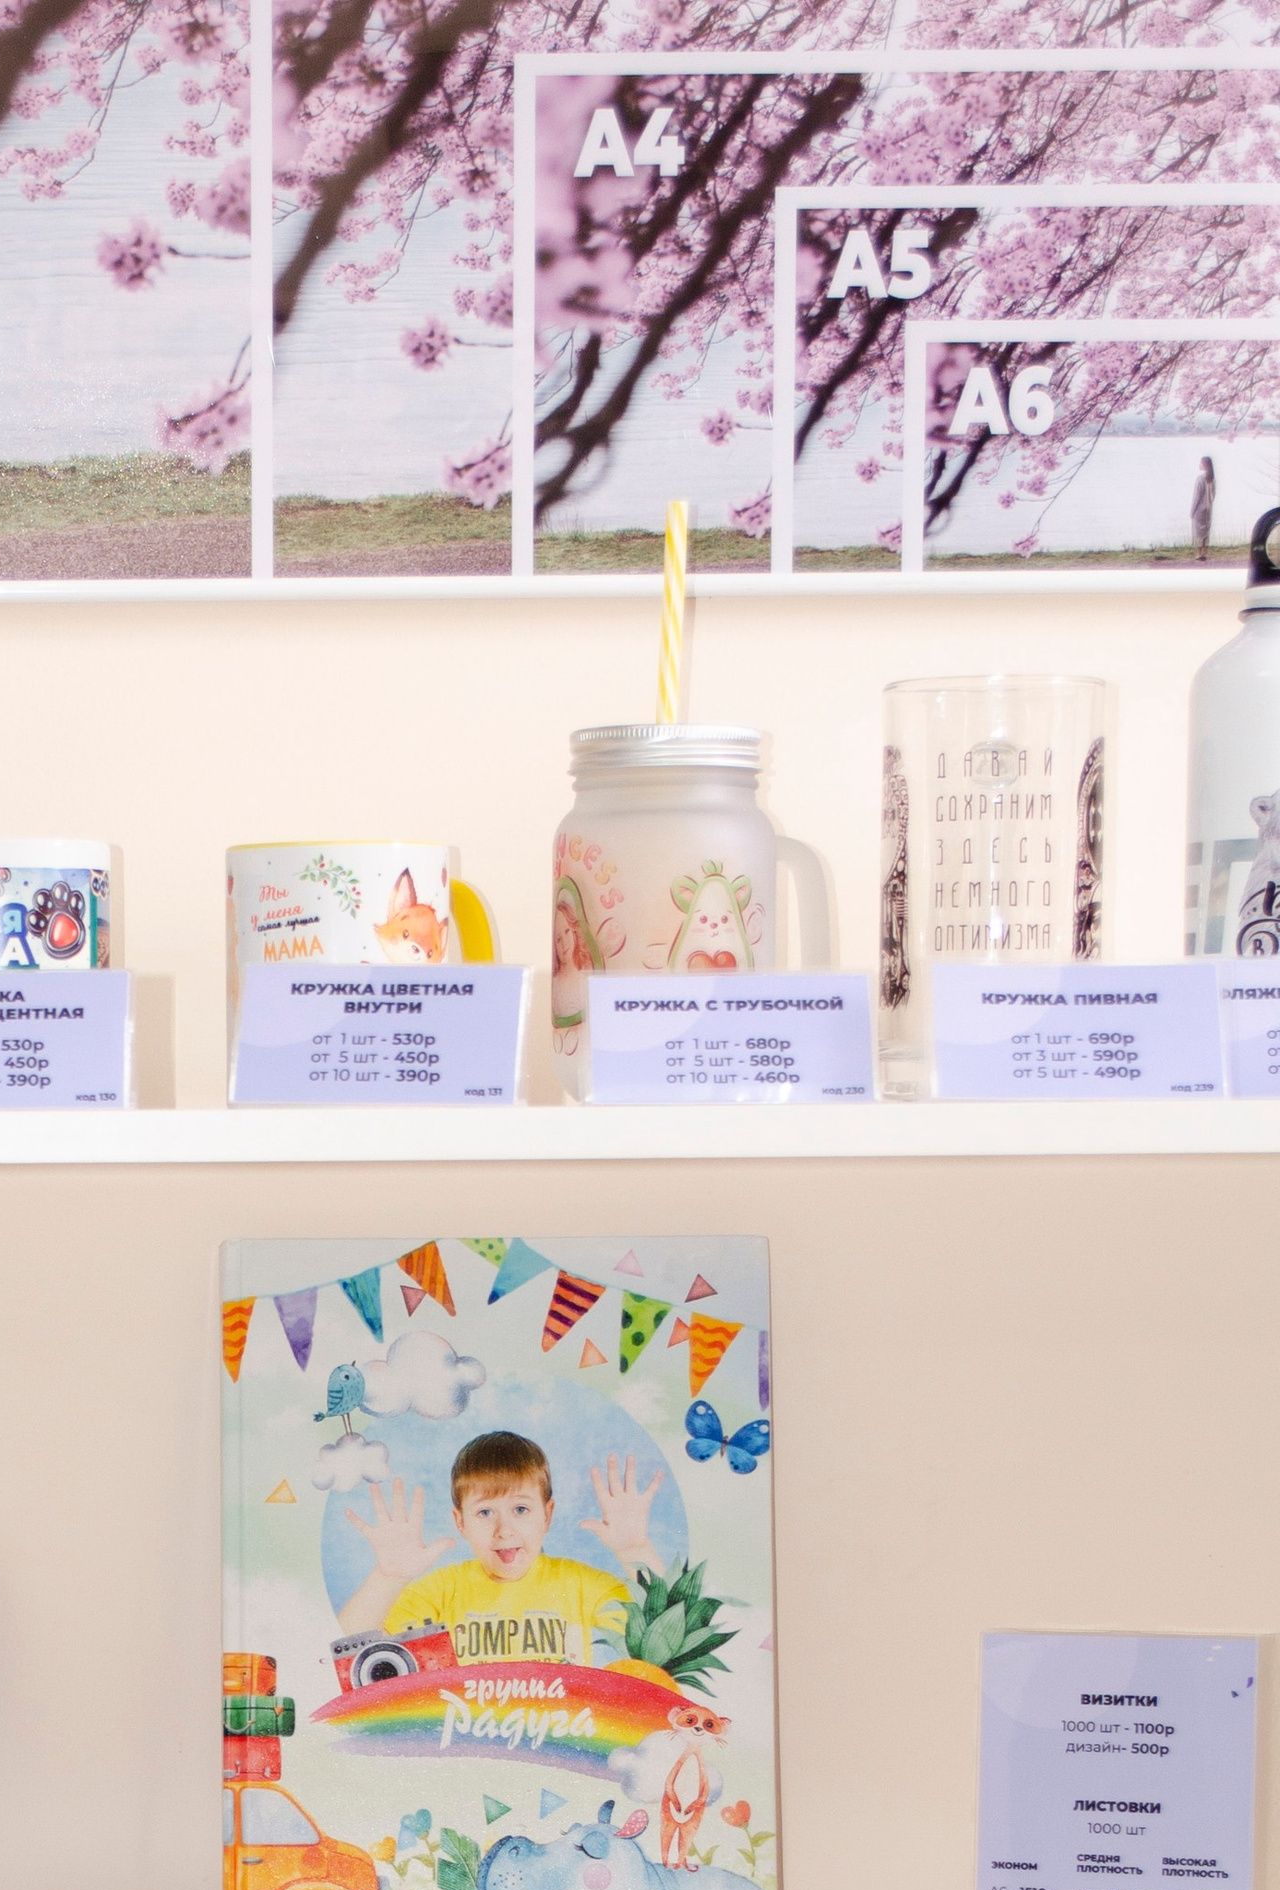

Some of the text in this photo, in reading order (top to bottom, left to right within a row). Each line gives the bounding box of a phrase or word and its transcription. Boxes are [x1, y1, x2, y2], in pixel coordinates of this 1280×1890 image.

[574, 108, 685, 178] A4
[827, 230, 933, 299] A5
[948, 367, 1055, 437] A6
[937, 748, 1053, 780] ДАВАЙ
[937, 793, 1052, 823] СОХРАНИМ
[936, 837, 1052, 866] ЗДЕСЬ
[935, 880, 1051, 908] НЕМНОГО
[934, 923, 1051, 952] ОПТИМИЗМА
[263, 934, 325, 963] МАМА
[291, 983, 474, 998] КРУЖКА ЦВЕТНАЯ
[614, 996, 843, 1012] КРУЖКА С ТРУБОЧКОЙ
[981, 992, 1159, 1006] КРУЖКА ПИВНАЯ
[344, 1002, 422, 1014] ВНУТРИ
[0, 1039, 45, 1054] 530р
[392, 1033, 436, 1046] 530р
[745, 1038, 791, 1051] 680р
[1088, 1032, 1135, 1047] 690р
[4, 1056, 50, 1071] 450р
[394, 1051, 440, 1065] 450р
[749, 1055, 795, 1068] 580р
[1092, 1049, 1139, 1064] 590р
[395, 1069, 441, 1083] 390р
[1094, 1066, 1142, 1081] 490р
[6, 1074, 51, 1089] 390р
[1170, 1084, 1215, 1093] код 239
[75, 1093, 117, 1103] код 130
[822, 1087, 865, 1096] код 230
[454, 1618, 567, 1658] COMPANY
[463, 1676, 568, 1707] группа
[1080, 1693, 1159, 1707] ВИЗИТКИ
[1061, 1719, 1175, 1738] 1000 шт 1100р
[1130, 1742, 1170, 1758] 500р
[1073, 1799, 1162, 1814] ЛИСТОВКИ
[1087, 1822, 1147, 1836] 1000 шт
[991, 1860, 1038, 1871] ЭКОНОМ
[1076, 1853, 1121, 1864] СРЕДНЯ
[1162, 1856, 1217, 1868] ВЫСОКАЯ
[1076, 1863, 1143, 1876] ПЛОТНОСТЬ
[1162, 1867, 1229, 1880] ПЛОТНОСТЬ
